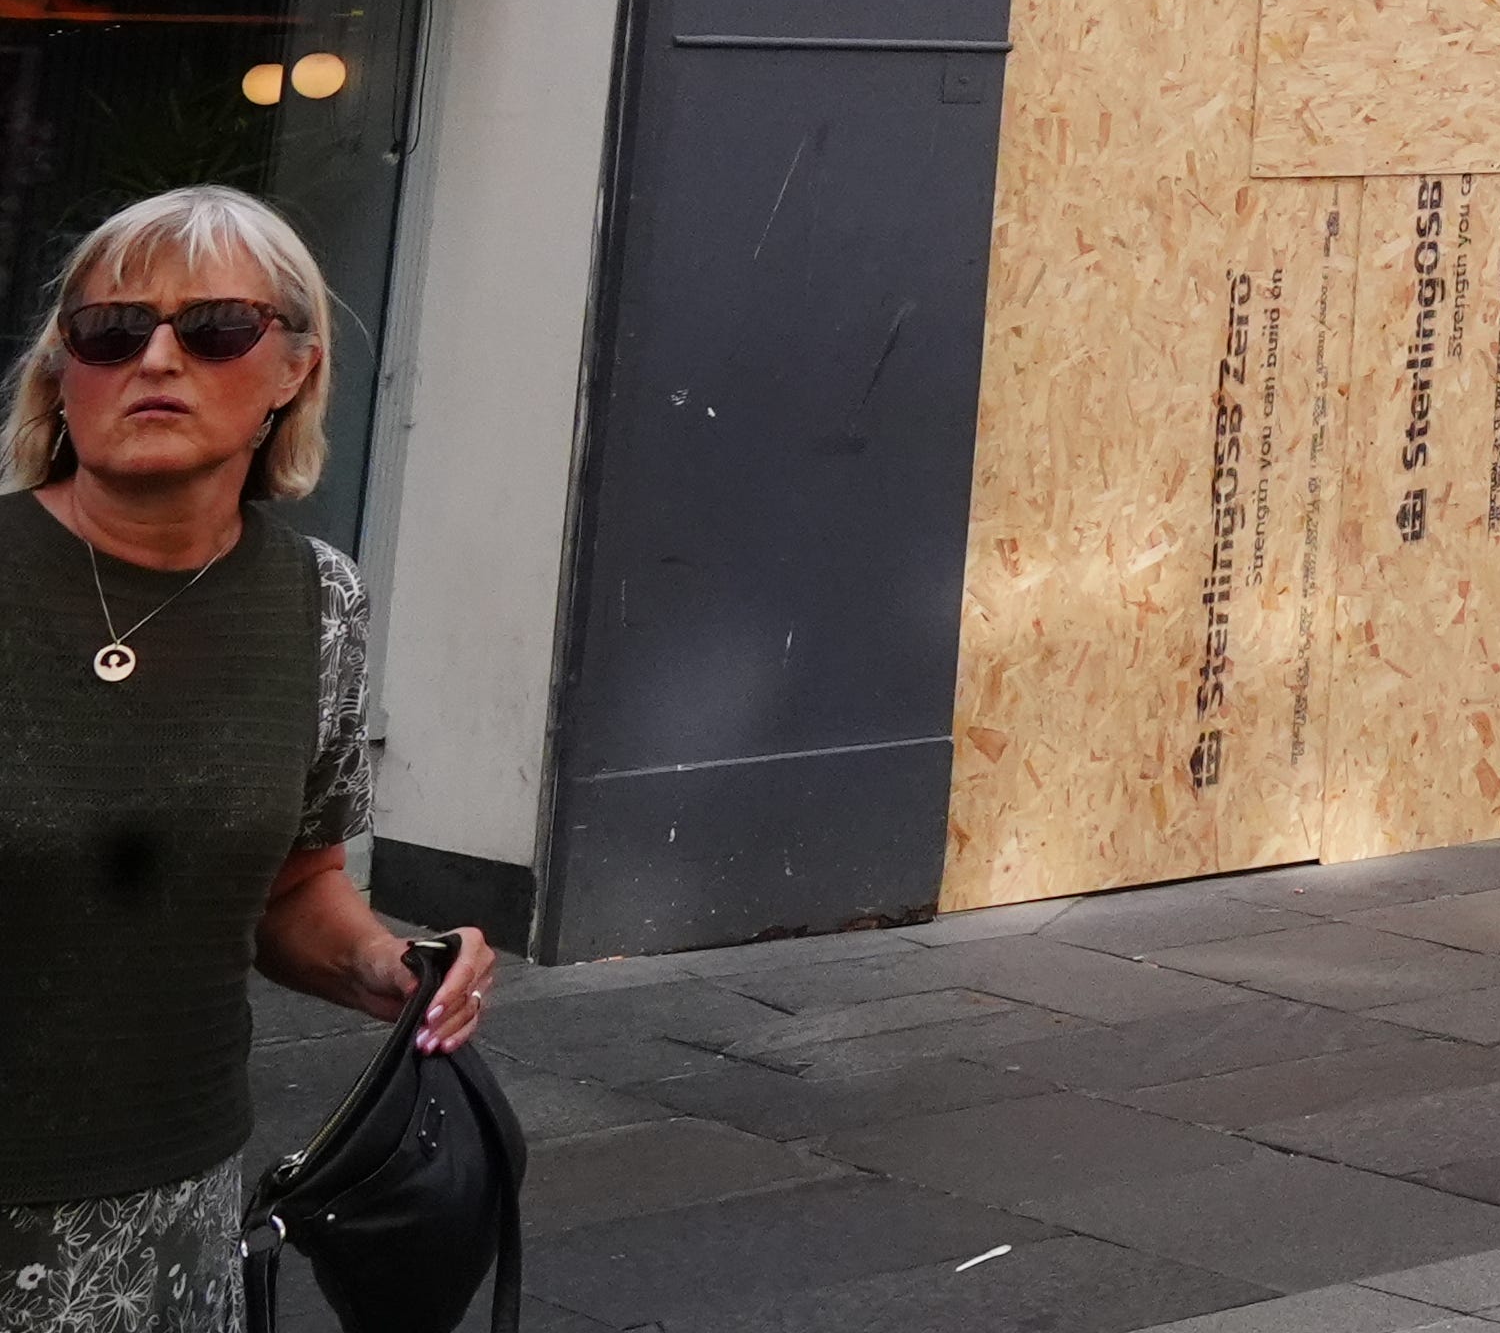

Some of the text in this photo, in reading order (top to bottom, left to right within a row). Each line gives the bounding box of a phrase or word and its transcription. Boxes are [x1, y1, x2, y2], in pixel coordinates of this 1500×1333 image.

[1457, 204, 1472, 246] you
[1447, 253, 1470, 361] Strength
[1246, 267, 1284, 589] Strength you can build on
